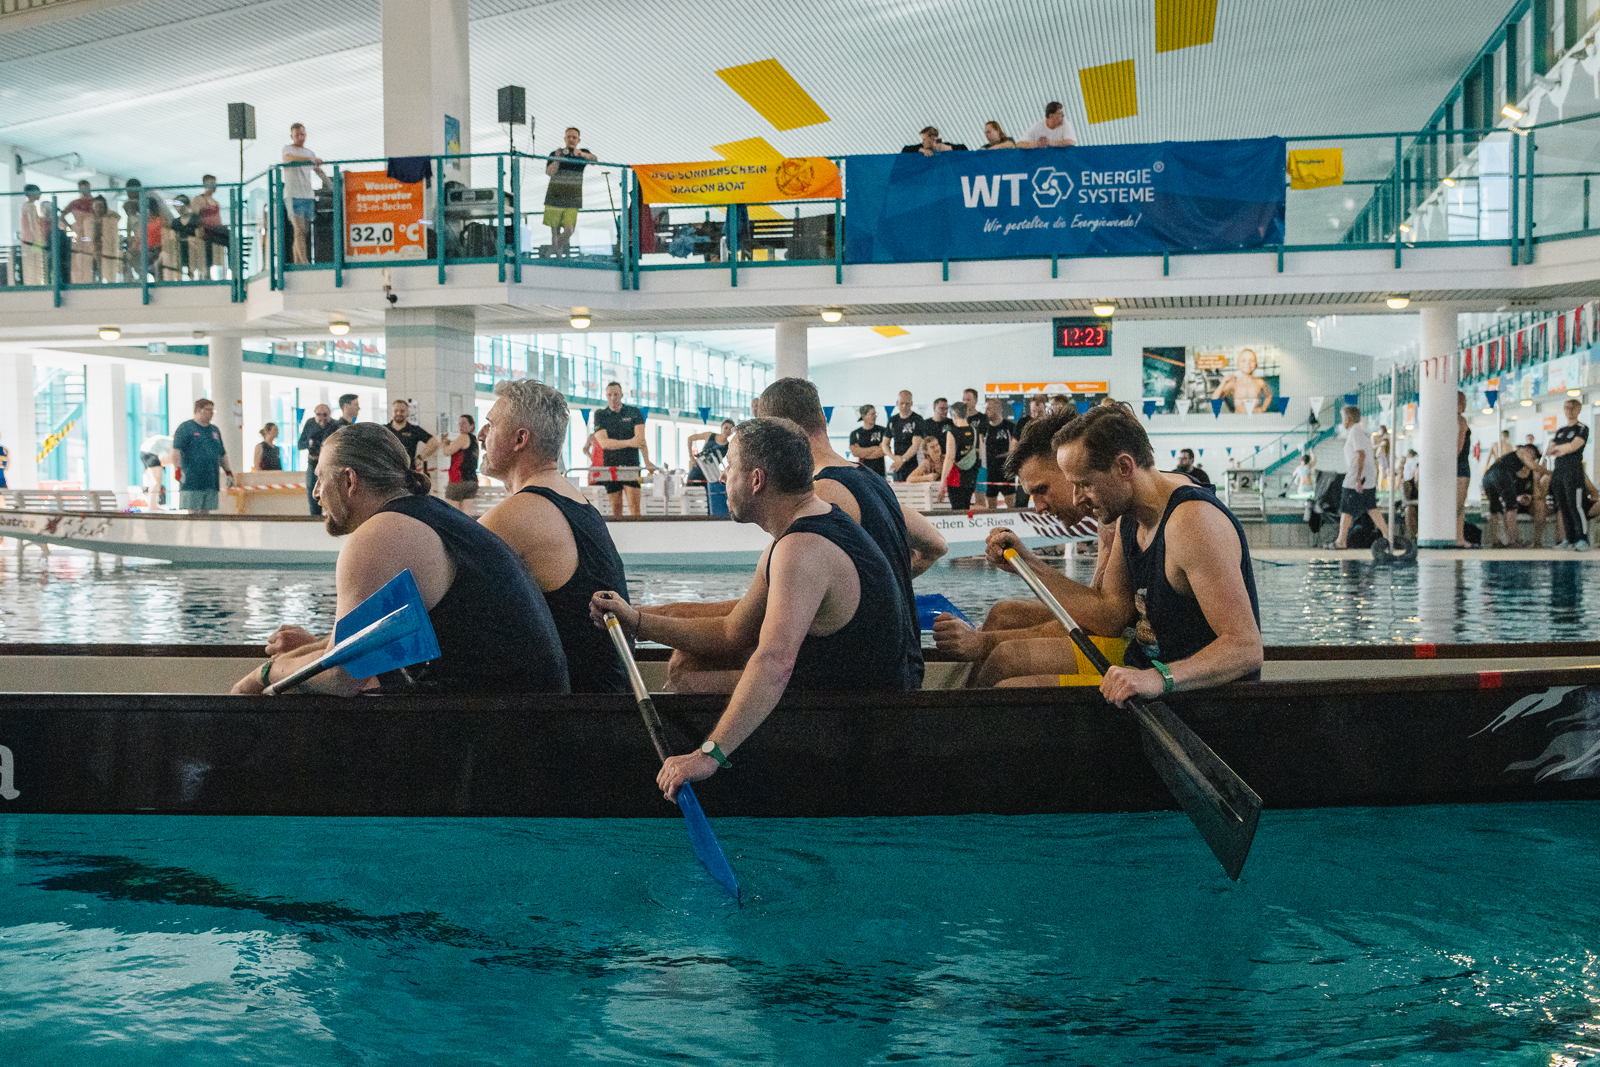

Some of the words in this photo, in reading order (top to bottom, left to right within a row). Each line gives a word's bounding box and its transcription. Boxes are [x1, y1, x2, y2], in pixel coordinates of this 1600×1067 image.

[678, 164, 767, 180] SONNENSCHEIN
[365, 182, 403, 191] Wasser-
[670, 183, 716, 194] DRAGON
[717, 181, 746, 191] BOAT
[960, 173, 1028, 208] WT
[356, 191, 412, 203] temperatur
[1078, 187, 1155, 204] SYSTEME
[356, 202, 413, 213] 25-m-Becken
[983, 217, 1002, 233] Wir
[1002, 215, 1050, 236] gestalten
[1052, 215, 1067, 229] die
[1070, 212, 1143, 233] Energiewende!
[352, 227, 393, 245] 32,0
[398, 223, 420, 242] °C
[1241, 476, 1250, 488] 2
[931, 519, 964, 530] chen
[968, 517, 1015, 528] SC-Riesa
